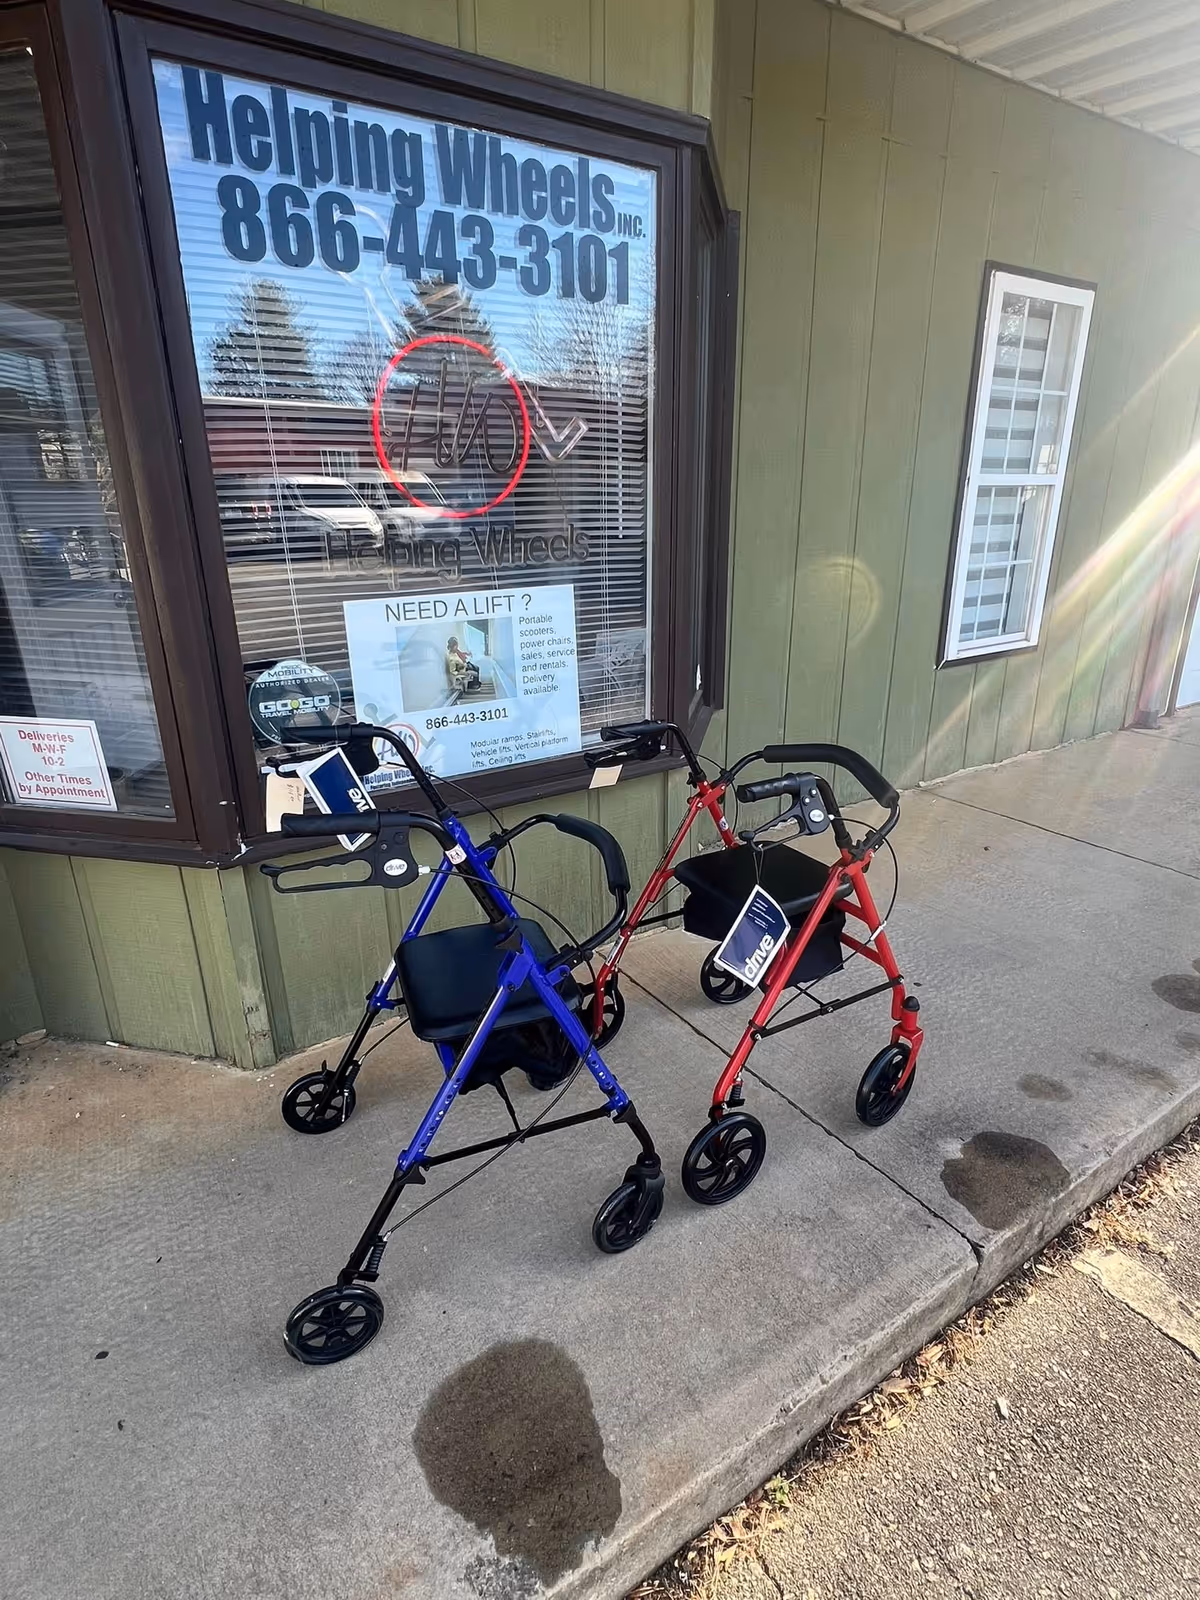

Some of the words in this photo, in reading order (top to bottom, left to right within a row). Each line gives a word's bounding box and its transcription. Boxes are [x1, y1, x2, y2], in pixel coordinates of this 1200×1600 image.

[181, 65, 426, 208] Helping
[434, 124, 615, 233] Wheels
[617, 212, 646, 238] INC.
[217, 175, 629, 305] 866-443-3101
[322, 526, 462, 588] Helping
[468, 523, 590, 567] Wheels
[385, 600, 448, 622] NEED
[454, 598, 468, 616] A
[474, 595, 515, 615] LIFT
[521, 593, 532, 611] ?
[519, 614, 552, 625] Portable
[519, 626, 556, 637] scooters,
[520, 640, 545, 651] power
[521, 651, 545, 661] sales,
[547, 648, 575, 658] service
[521, 662, 537, 673] and
[540, 659, 569, 670] rentals.
[268, 669, 314, 677] MOBILITY
[523, 674, 555, 684] Delivery
[255, 679, 301, 688] AUTHORIZED
[261, 710, 292, 718] TRAVEL
[294, 706, 330, 714] MOBILITY
[426, 707, 508, 730] 866-443-3101
[18, 729, 74, 742] Deliveries
[32, 743, 66, 754] M-W-F
[470, 738, 499, 748] Modular
[471, 748, 497, 758] Vehicle
[514, 742, 540, 751] Vertical
[541, 736, 568, 747] platform
[41, 756, 65, 766] 10-2
[488, 755, 512, 766] Ceiling
[25, 771, 55, 783] Other
[57, 773, 92, 785] Times
[364, 772, 394, 785] Helping
[18, 782, 31, 795] by
[36, 784, 106, 798] Appointment
[385, 863, 406, 872] drive
[744, 933, 775, 979] drive
